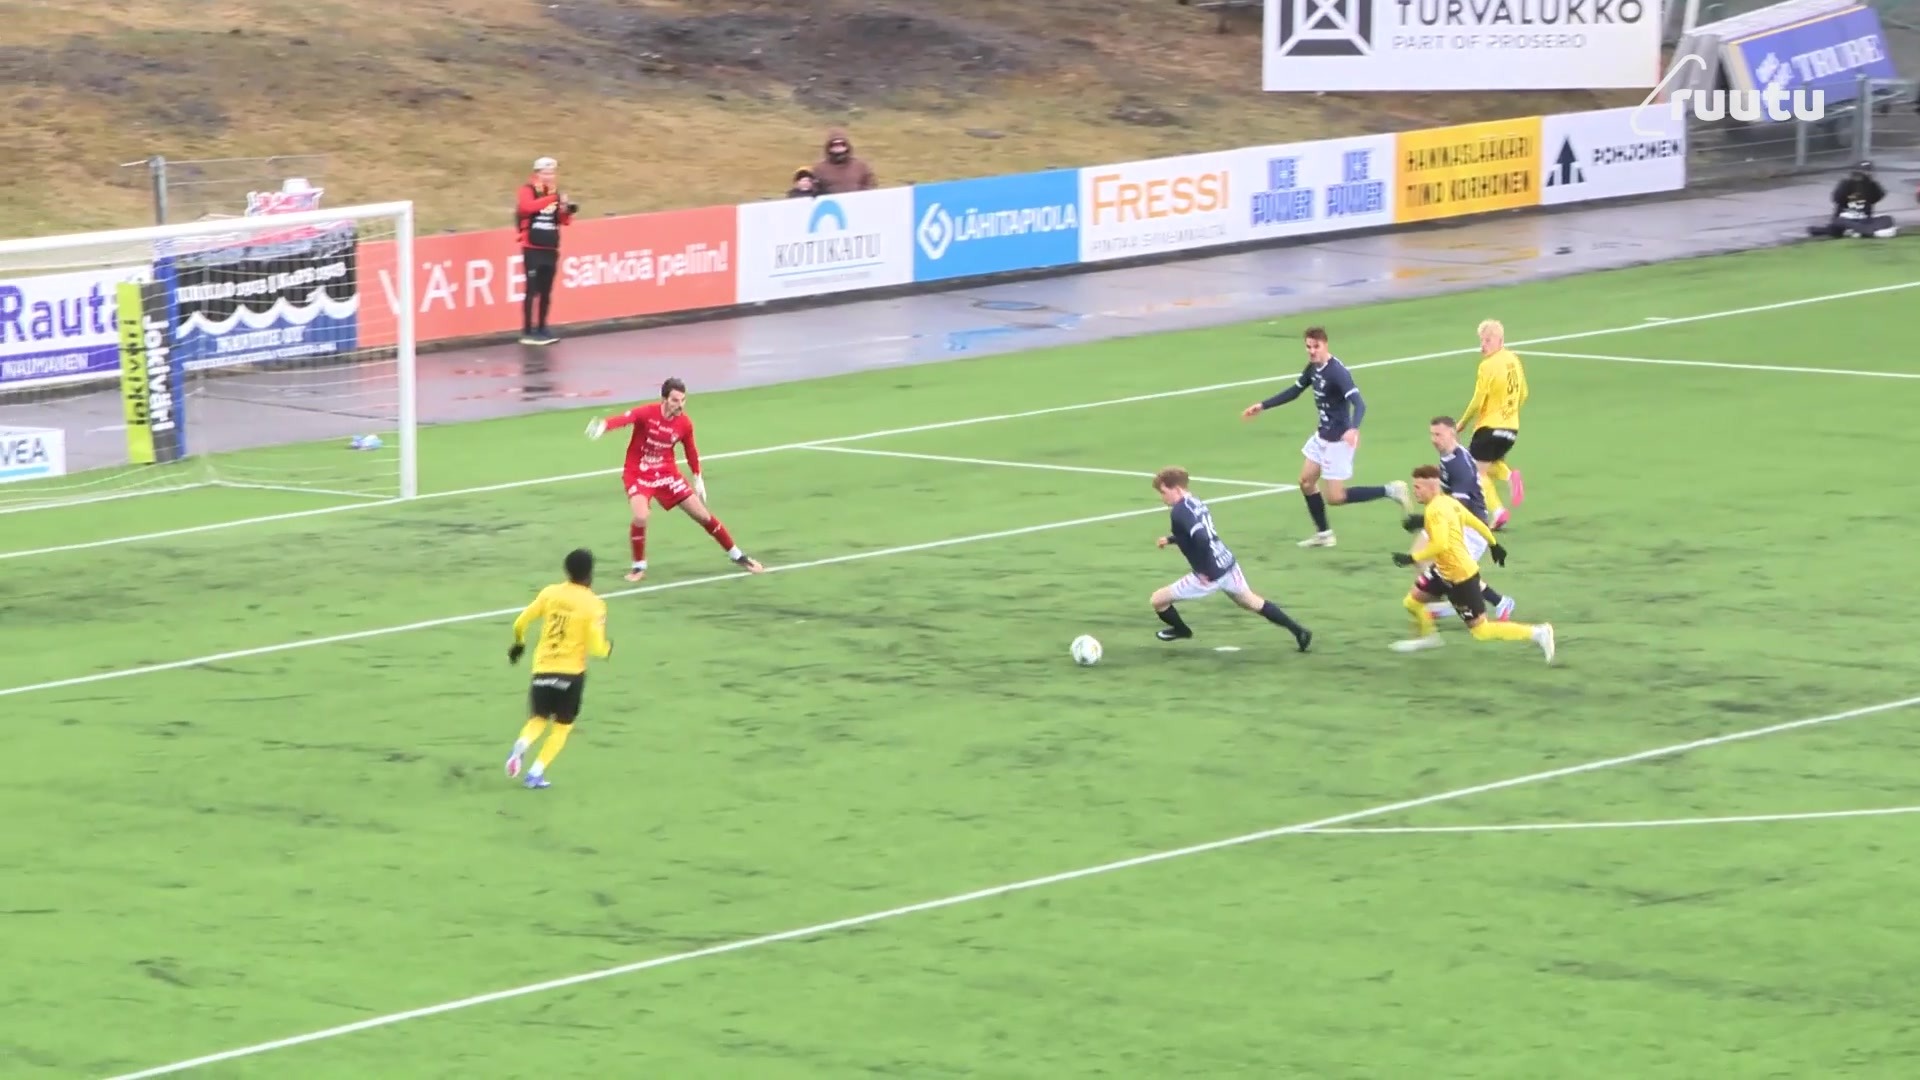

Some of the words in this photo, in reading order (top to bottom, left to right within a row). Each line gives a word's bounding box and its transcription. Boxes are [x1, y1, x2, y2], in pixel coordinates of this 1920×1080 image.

[1397, 0, 1643, 25] TURVALUKKO
[1393, 34, 1445, 50] PART
[1453, 34, 1481, 49] OF
[1487, 33, 1587, 49] PROSERO
[1343, 149, 1372, 182] ICE
[1592, 138, 1684, 166] POHJONEN
[1268, 156, 1299, 190] ICE
[1252, 188, 1315, 226] POWER
[1325, 180, 1386, 218] POWER
[954, 201, 1078, 242] LÄHITAPIOLA
[562, 248, 656, 289] Sähköä
[656, 241, 729, 286] peliin!
[775, 232, 881, 270] KOTIKATU
